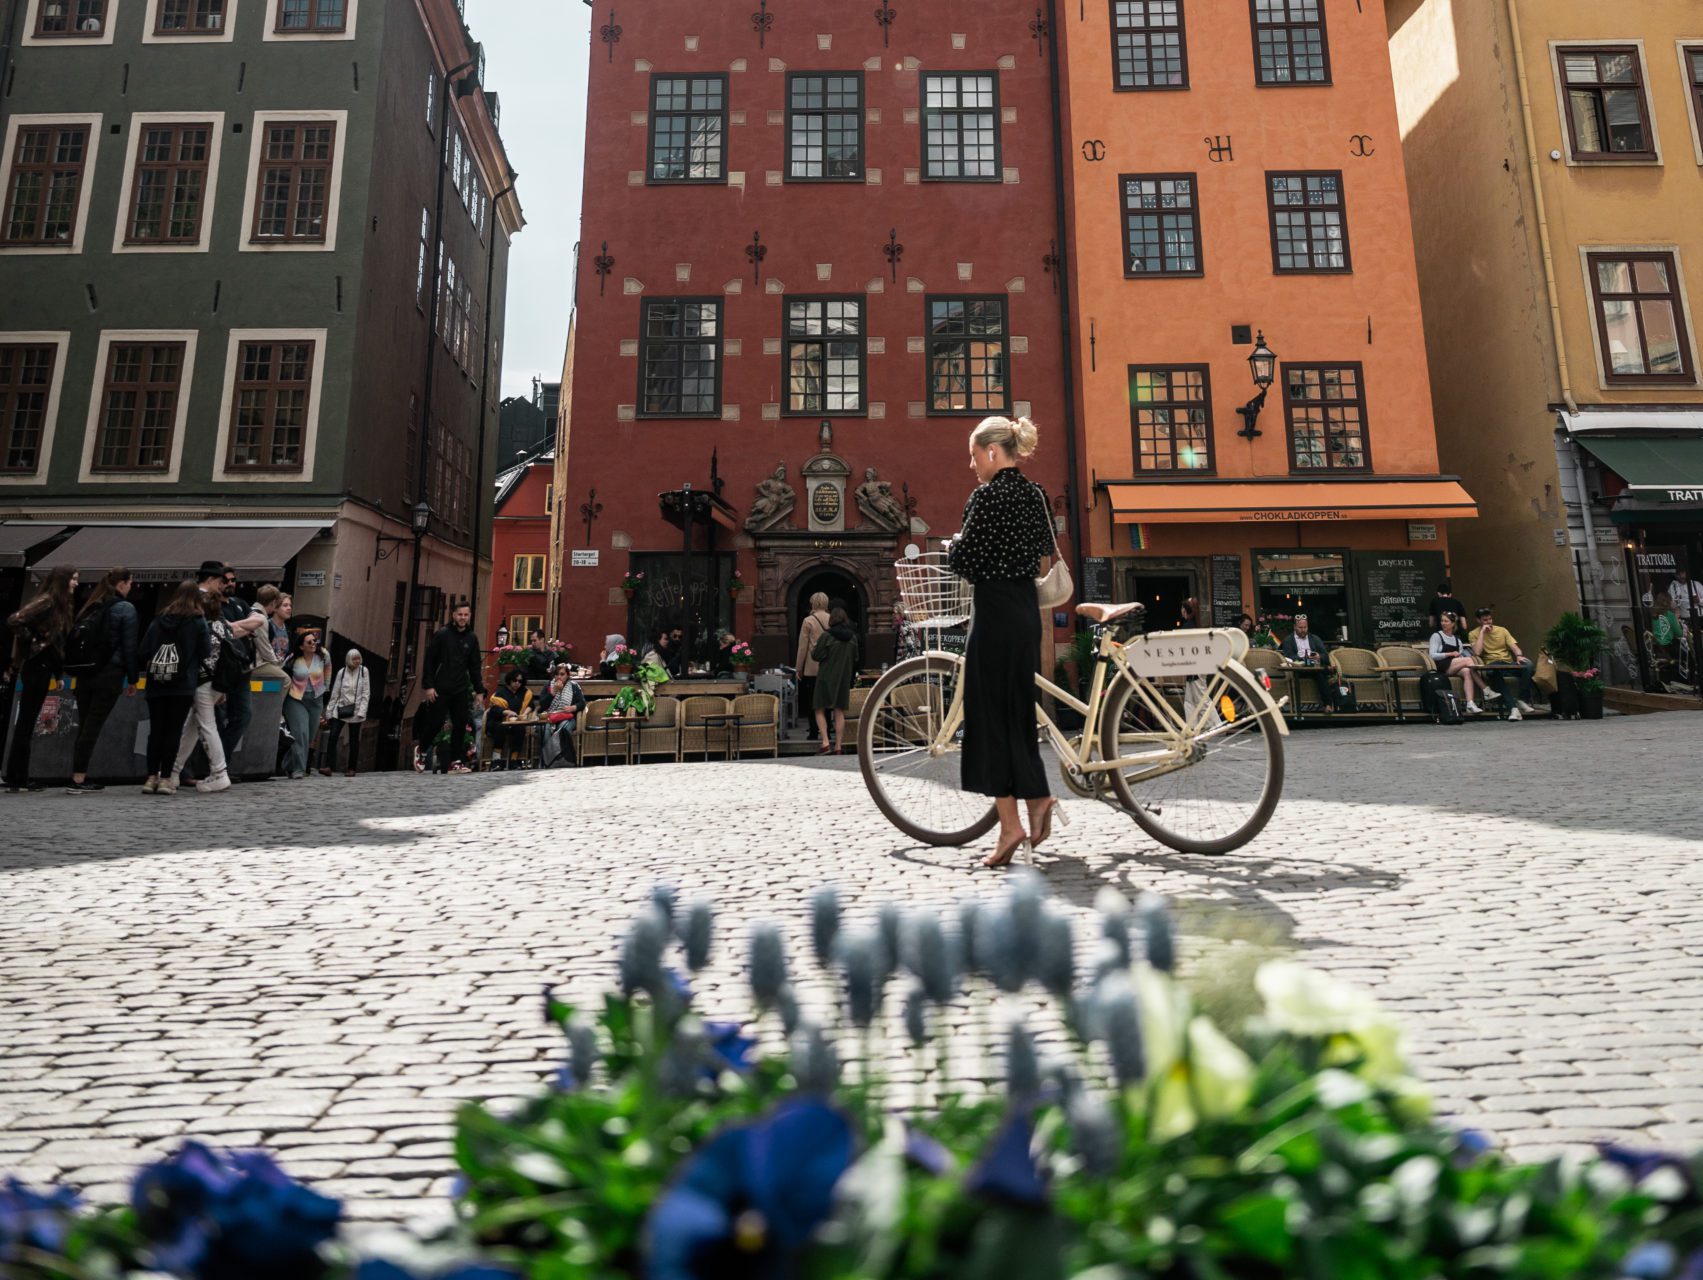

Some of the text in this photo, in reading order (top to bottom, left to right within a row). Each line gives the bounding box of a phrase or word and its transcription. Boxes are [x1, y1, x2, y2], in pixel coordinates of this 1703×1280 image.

[573, 551, 596, 559] Stortorget
[1636, 553, 1676, 566] TRATTORIA
[1144, 645, 1212, 658] NESTOR
